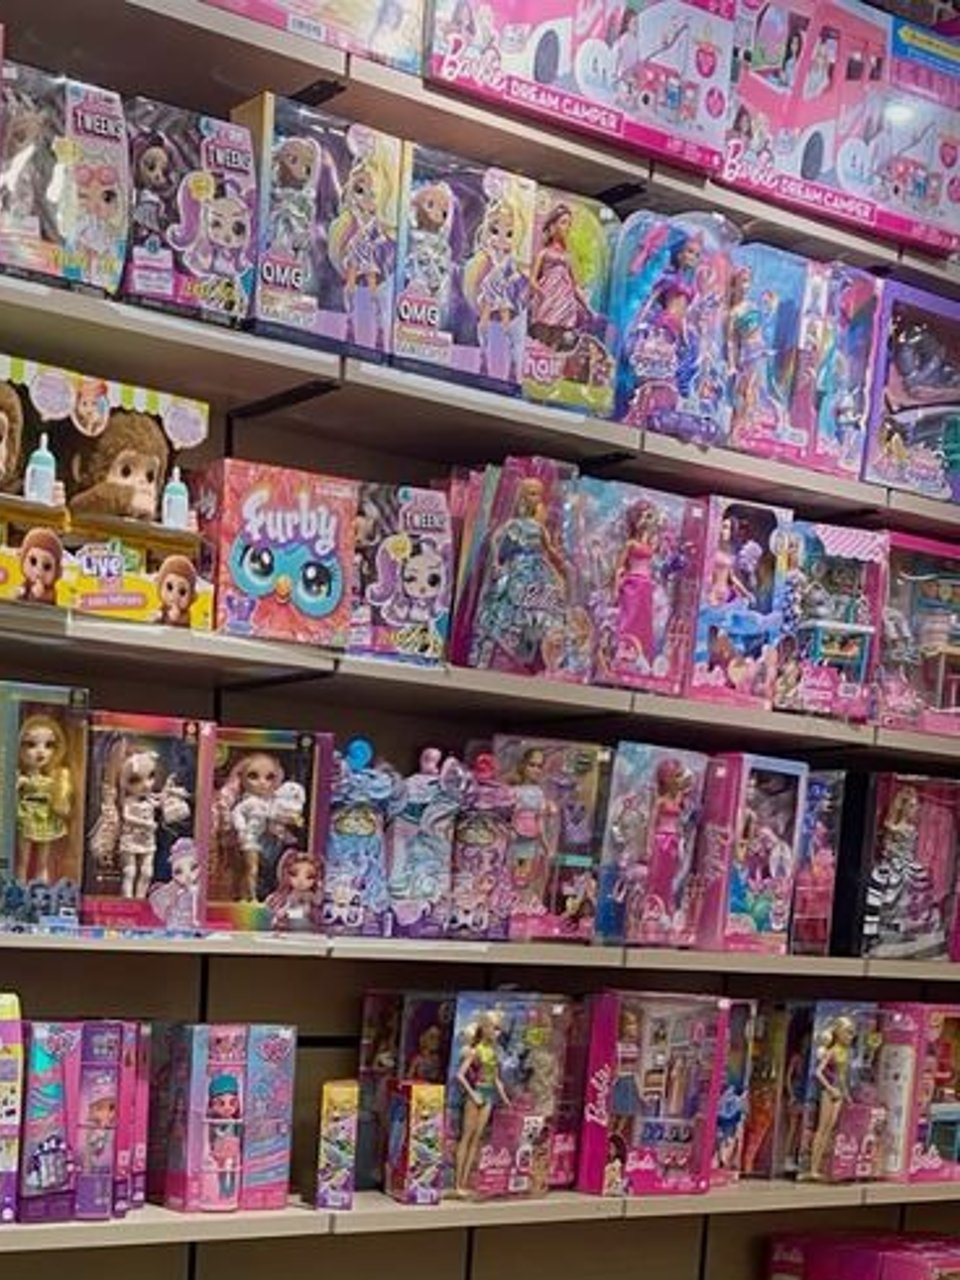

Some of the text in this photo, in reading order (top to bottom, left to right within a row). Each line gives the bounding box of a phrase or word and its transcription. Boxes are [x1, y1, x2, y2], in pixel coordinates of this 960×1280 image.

[442, 33, 618, 131] Barbie DREAM CAMPER
[76, 107, 124, 139] TWEENS
[209, 144, 253, 173] TWEENS
[724, 140, 779, 189] Barbie
[780, 178, 822, 202] DREAM
[824, 191, 871, 219] CAMPER
[263, 260, 304, 289] OMG
[399, 299, 439, 325] OMG
[242, 489, 338, 554] Furby
[82, 554, 123, 578] Live
